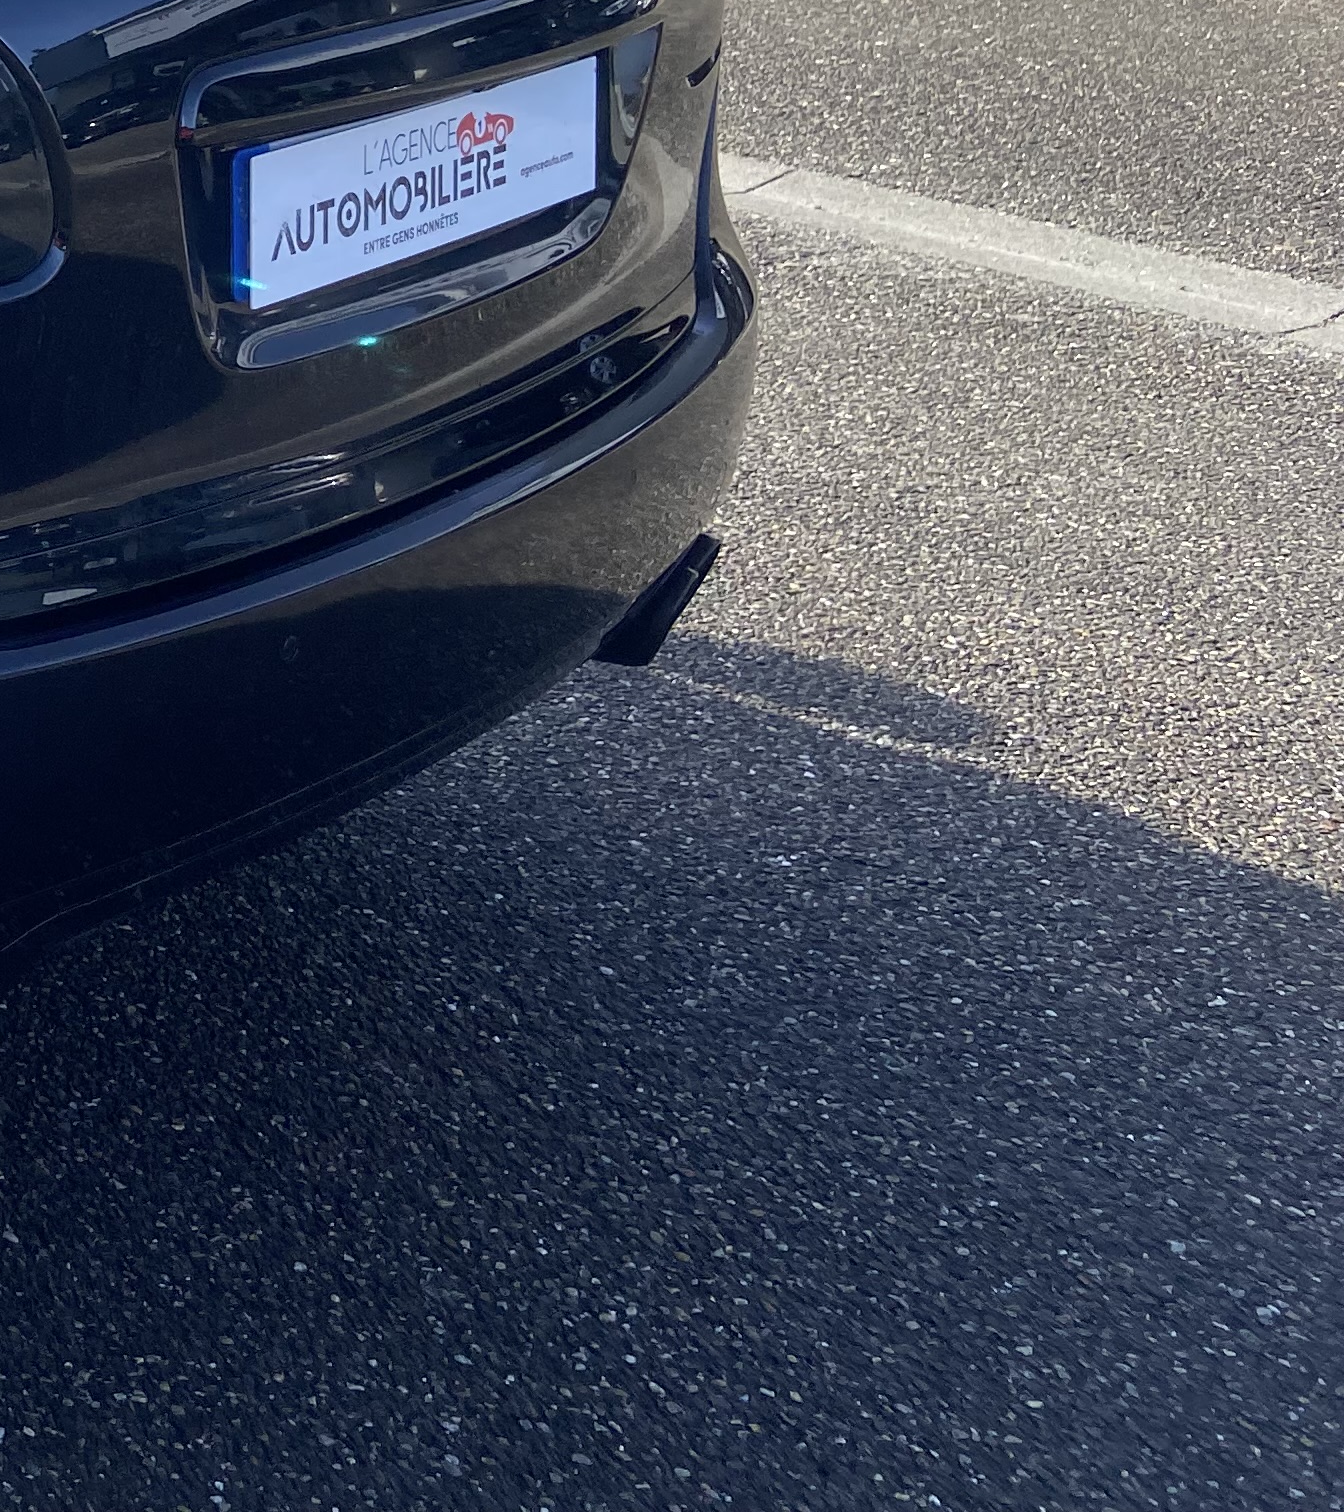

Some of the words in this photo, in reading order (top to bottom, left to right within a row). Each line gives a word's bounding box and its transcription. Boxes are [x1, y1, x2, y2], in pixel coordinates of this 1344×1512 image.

[363, 117, 458, 176] L'AGENCE
[363, 235, 391, 255] ENTRE
[392, 227, 415, 244] GENS
[416, 212, 459, 238] HONNÊTES
